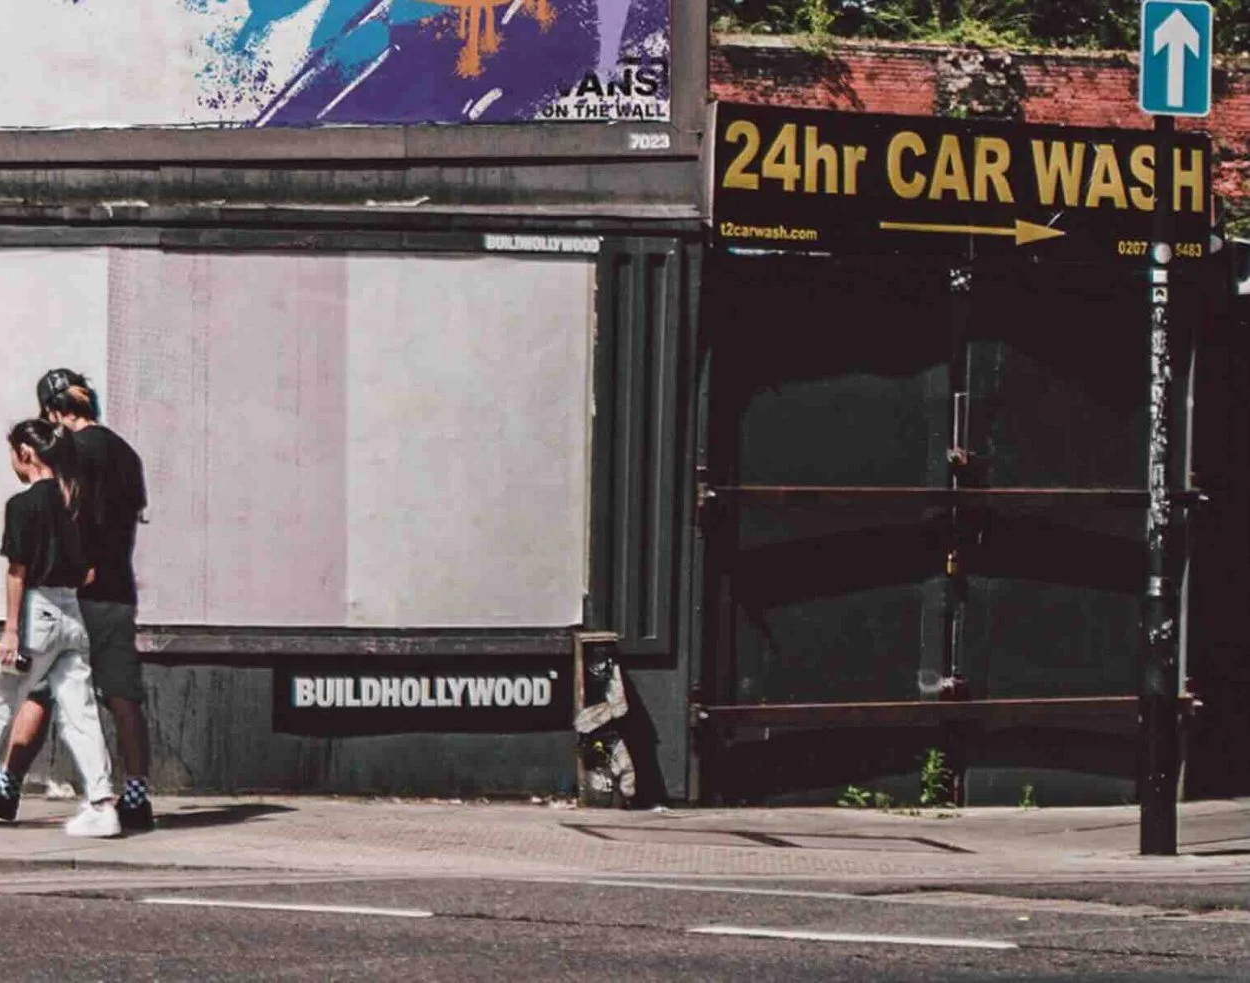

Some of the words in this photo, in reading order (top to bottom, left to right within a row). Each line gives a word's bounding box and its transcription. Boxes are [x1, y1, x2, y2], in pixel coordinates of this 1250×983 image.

[575, 103, 611, 118] THE
[616, 103, 666, 118] WALL
[723, 120, 867, 196] 24hr
[886, 130, 1014, 204] CAR
[1031, 138, 1204, 213] WASH
[1118, 240, 1149, 256] 0207
[294, 671, 558, 708] BUILDHOLLYWOOD
